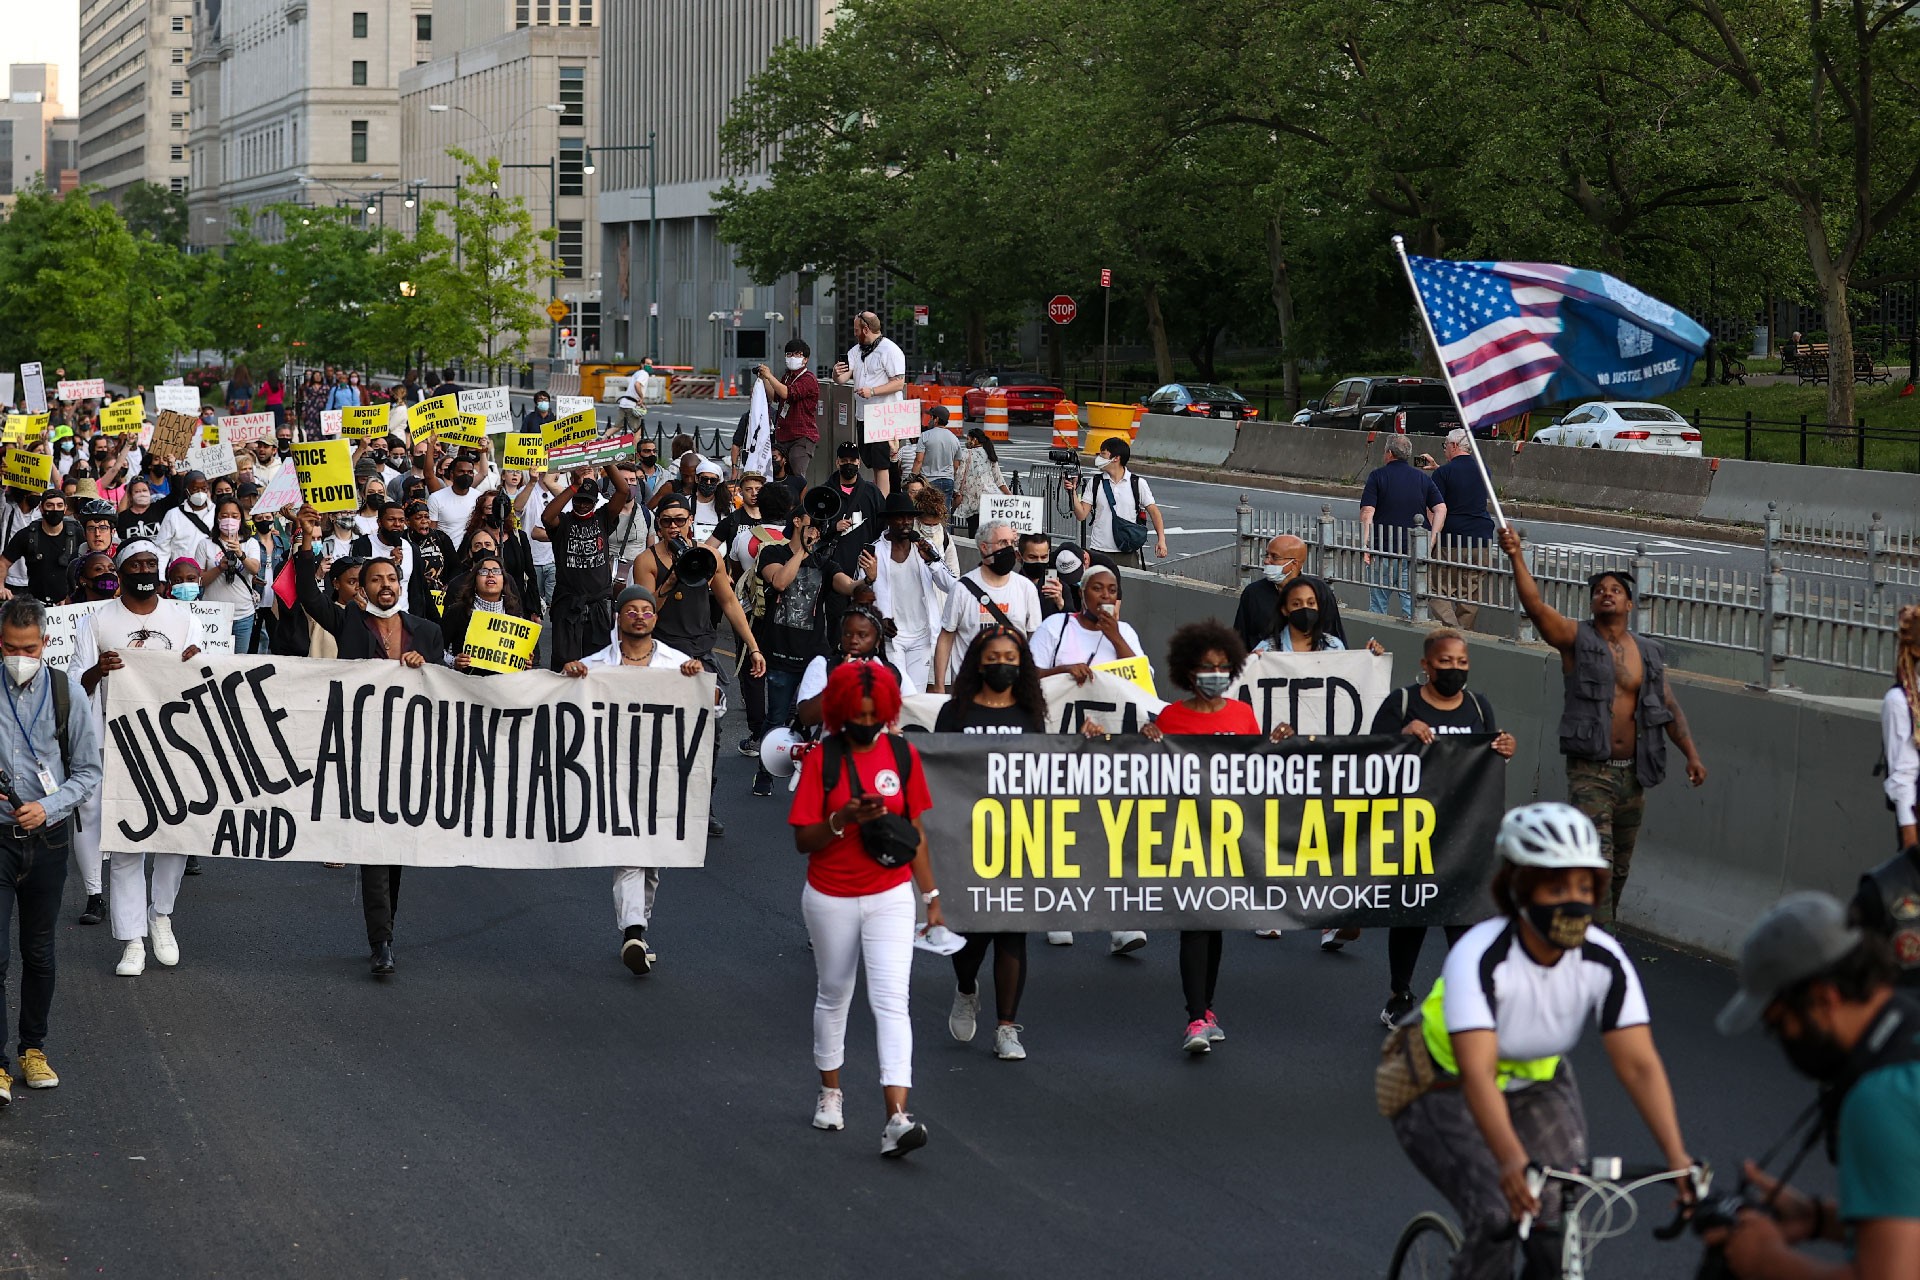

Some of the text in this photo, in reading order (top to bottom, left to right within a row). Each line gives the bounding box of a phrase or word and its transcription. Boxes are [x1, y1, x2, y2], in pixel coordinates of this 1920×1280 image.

[1050, 304, 1074, 316] STOP
[1597, 373, 1610, 386] NO
[462, 393, 473, 401] ONE
[416, 400, 444, 416] JUSTICE
[496, 400, 503, 408] IS
[873, 402, 919, 418] SILENCE
[109, 408, 132, 416] JUSTICE
[354, 408, 380, 418] JUSTICE
[159, 411, 196, 433] BLACK
[223, 414, 271, 427] WE WANT
[412, 416, 460, 438] GEORGE FLOYD
[460, 416, 477, 426] STICE
[554, 415, 583, 431] JUSTICE
[884, 416, 895, 426] IS
[102, 424, 123, 432] GEORGE
[228, 426, 271, 441] JUSTICE
[342, 425, 388, 435] GEORGE FLOYD
[563, 426, 573, 434] FOR
[868, 426, 920, 440] VIOLENCE
[518, 438, 542, 446] JUSTIC
[544, 428, 596, 451] GEORGE FLOYD
[14, 453, 40, 466] JUSTICE
[292, 448, 327, 466] STICE
[505, 456, 534, 466] GEORGE
[21, 466, 30, 474] FOR
[205, 462, 233, 477] ATTERS
[4, 472, 48, 488] GEORGE FLOYD
[311, 484, 354, 503] FLOYD
[991, 498, 1019, 508] INVEST
[1011, 521, 1032, 531] POLICE
[190, 602, 220, 615] Power
[46, 615, 62, 625] ne
[487, 618, 530, 640] JUSTICE
[498, 637, 515, 650] FOR
[464, 644, 508, 664] GEORGE
[988, 753, 1422, 796] REMEMBERING GEORGE FLOYD
[212, 807, 296, 859] AND
[971, 798, 1436, 879] ONE YEAR LATER
[967, 882, 1439, 912] THE DAY THE WORLD WOKE UP
